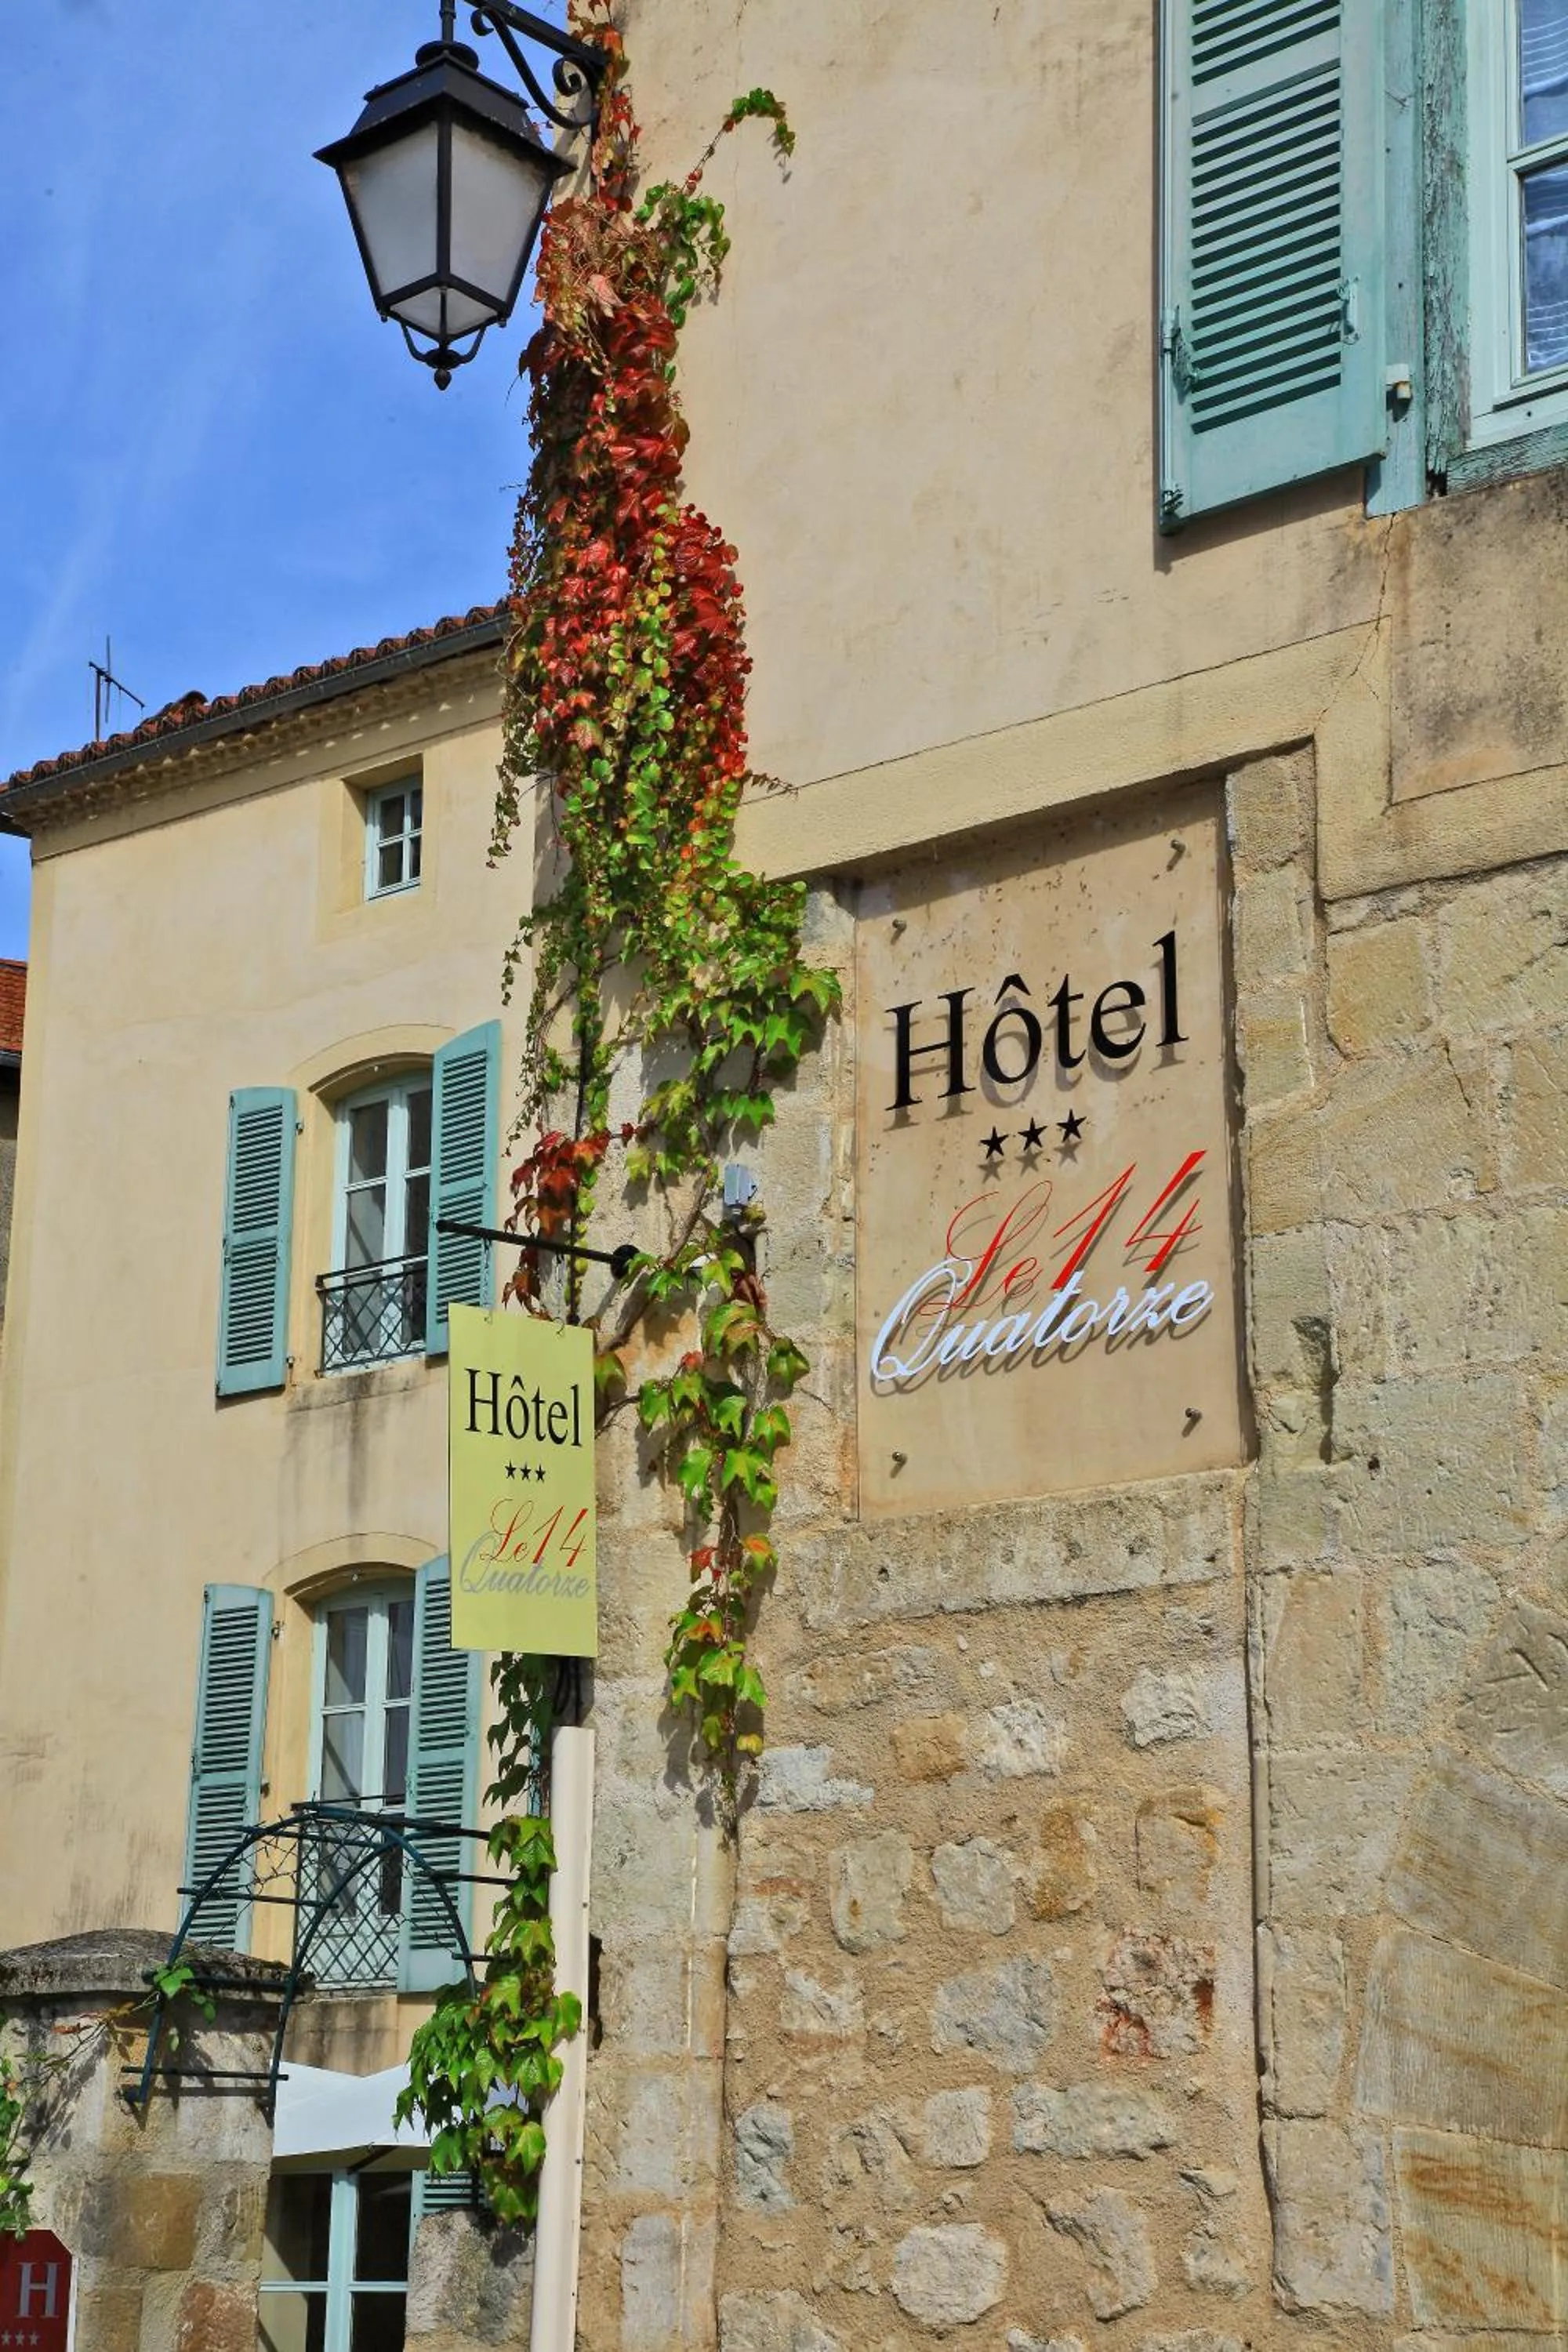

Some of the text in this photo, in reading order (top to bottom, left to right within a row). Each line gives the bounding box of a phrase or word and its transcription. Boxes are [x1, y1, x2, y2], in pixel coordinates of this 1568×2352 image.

[885, 930, 1189, 1112] Hôtel
[915, 1149, 1207, 1316] Le 14
[870, 1257, 1215, 1381] Quatorze
[464, 1367, 583, 1447] Hôtel
[459, 1530, 590, 1599] Quatorze
[479, 1497, 589, 1567] Le 14
[15, 2261, 63, 2319] H
